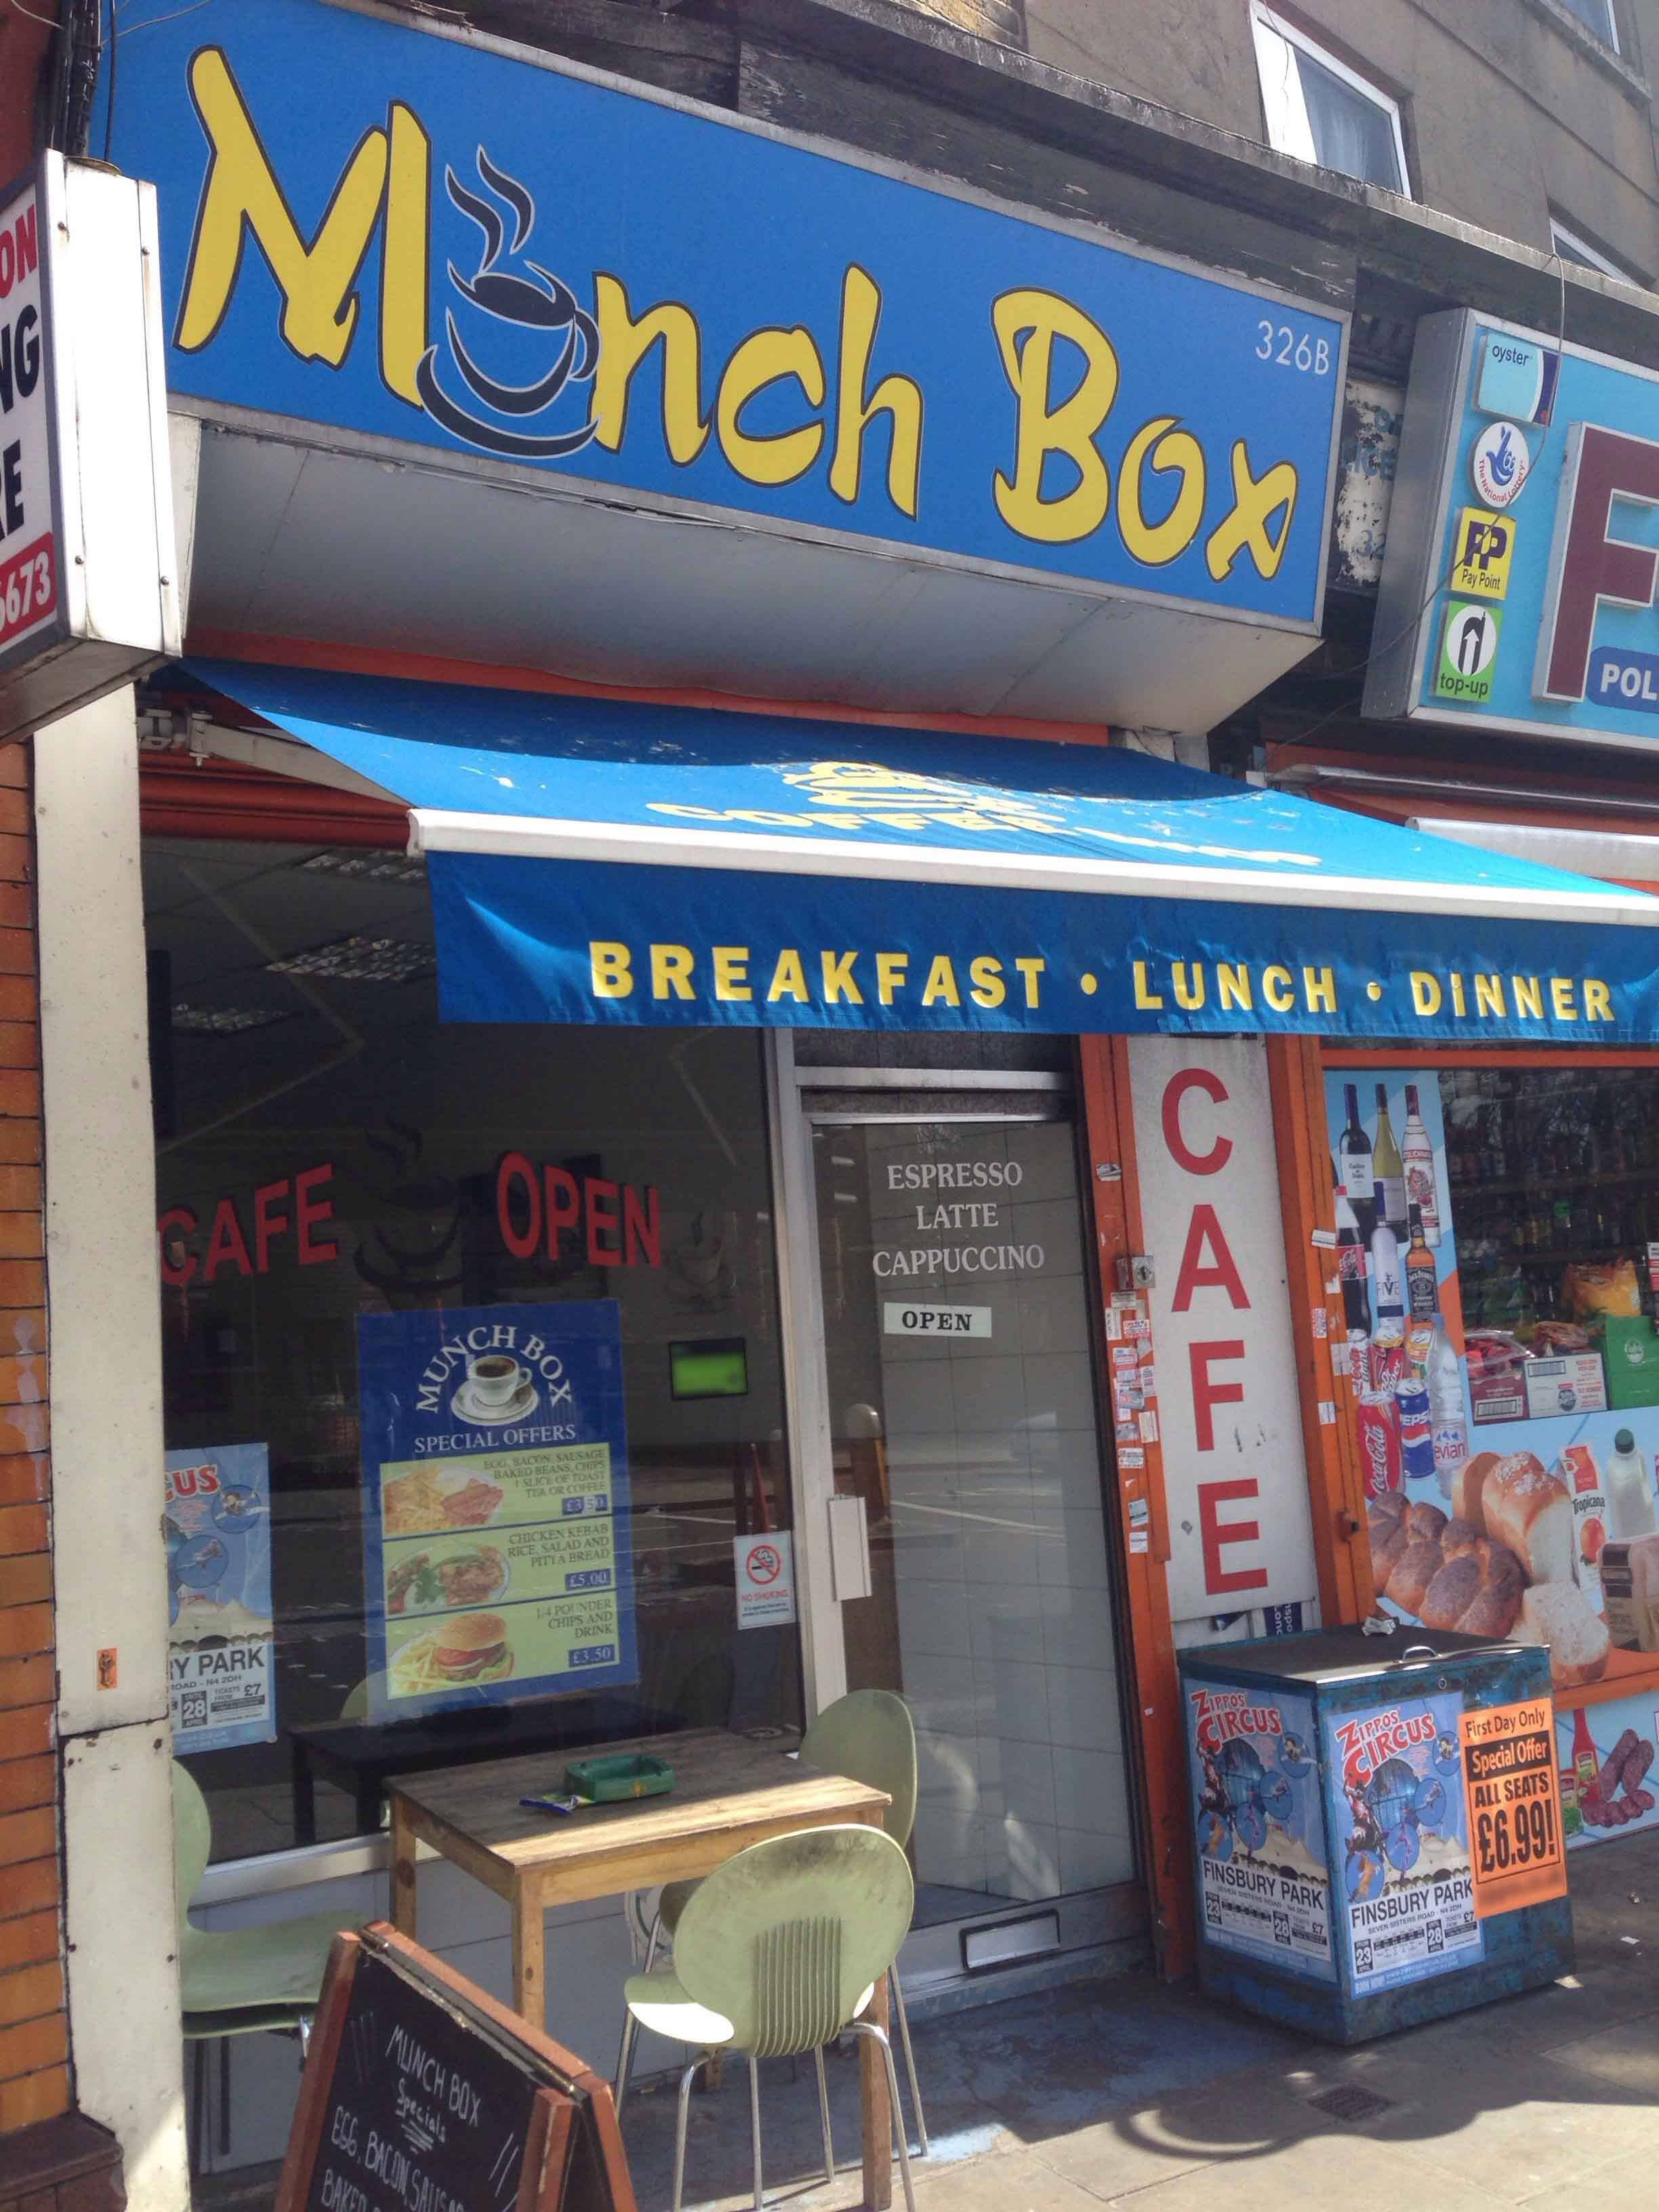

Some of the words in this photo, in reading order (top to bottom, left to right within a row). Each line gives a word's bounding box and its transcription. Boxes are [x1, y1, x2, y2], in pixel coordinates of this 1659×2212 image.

[1255, 320, 1330, 375] 326B
[1492, 345, 1529, 367] oyster
[991, 286, 1299, 583] Box
[0, 439, 24, 541] E
[1481, 478, 1509, 502] National
[1461, 568, 1478, 589] Pay
[1479, 571, 1500, 590] Point
[1440, 673, 1489, 699] top-up
[589, 941, 1046, 1009] BREAKFAST
[1132, 960, 1337, 1014] LUNCH
[1410, 970, 1616, 1022] DINNER
[887, 1162, 1023, 1190] ESPRESSO
[496, 1150, 662, 1269] OPEN
[916, 1203, 999, 1230] LATTE
[156, 1162, 338, 1286] CAFE
[873, 1244, 1044, 1277] CAPPUCCINO
[902, 1310, 972, 1332] OPEN
[1162, 1067, 1268, 1597] CAFE
[416, 1324, 518, 1414] MUNCH
[520, 1334, 573, 1408] BOX
[414, 1430, 499, 1454] SPECIAL
[503, 1423, 576, 1446] OFFERS
[1434, 1441, 1466, 1460] evian
[556, 1450, 605, 1461] SAUSAGE
[494, 1468, 533, 1480] BAKED
[576, 1459, 606, 1471] CHIPS
[521, 1476, 554, 1488] SLICE
[555, 1475, 570, 1485] OF
[572, 1471, 606, 1483] TOAST
[165, 1465, 221, 1502] US
[550, 1486, 565, 1496] OR
[566, 1481, 605, 1494] COFFEE
[1572, 1495, 1605, 1515] Tropicana
[509, 1528, 565, 1545] CHICKEN
[568, 1523, 609, 1538] KEBAB
[541, 1539, 581, 1553] SALAD
[583, 1536, 609, 1548] AND
[531, 1555, 566, 1568] PITTA
[569, 1549, 610, 1563] BREAD
[569, 1571, 609, 1588] £5.00
[548, 1615, 584, 1630] CHIPS
[588, 1611, 613, 1624] AND
[554, 1599, 613, 1617] POUNDER
[575, 1624, 613, 1639] DRINK
[199, 1646, 265, 1677] PARK
[573, 1647, 611, 1664] £3.50
[243, 1683, 262, 1696] £7
[182, 1699, 206, 1719] 28
[1197, 1707, 1284, 1755] CIRCUS
[1465, 1718, 1492, 1739] First
[1495, 1715, 1516, 1734] Day
[1519, 1707, 1546, 1727] Only
[1343, 1712, 1438, 1788] CIRCUS
[1473, 1742, 1515, 1779] Special
[1516, 1737, 1547, 1761] Offer
[1475, 1783, 1501, 1809] ALL
[1504, 1771, 1549, 1803] SEATS
[1477, 1799, 1556, 1874] £6.99!
[1203, 1860, 1276, 1897] FINSBURY
[1280, 1881, 1325, 1910] PARK
[1351, 1889, 1429, 1928] FINSBURY
[1434, 1878, 1473, 1907] PARK
[1311, 1922, 1324, 1935] £7
[1368, 1924, 1389, 1935] SEVEN
[1389, 1915, 1416, 1927] SISTERS
[1417, 1911, 1435, 1921] ROAD
[1463, 1911, 1475, 1923] £7
[1428, 1927, 1443, 1944] 28
[1355, 1947, 1372, 1965] 23
[385, 2024, 446, 2099] MUNCH
[448, 2073, 482, 2128] BOX
[395, 2077, 445, 2144] Specials
[409, 2169, 466, 2212] SAUS
